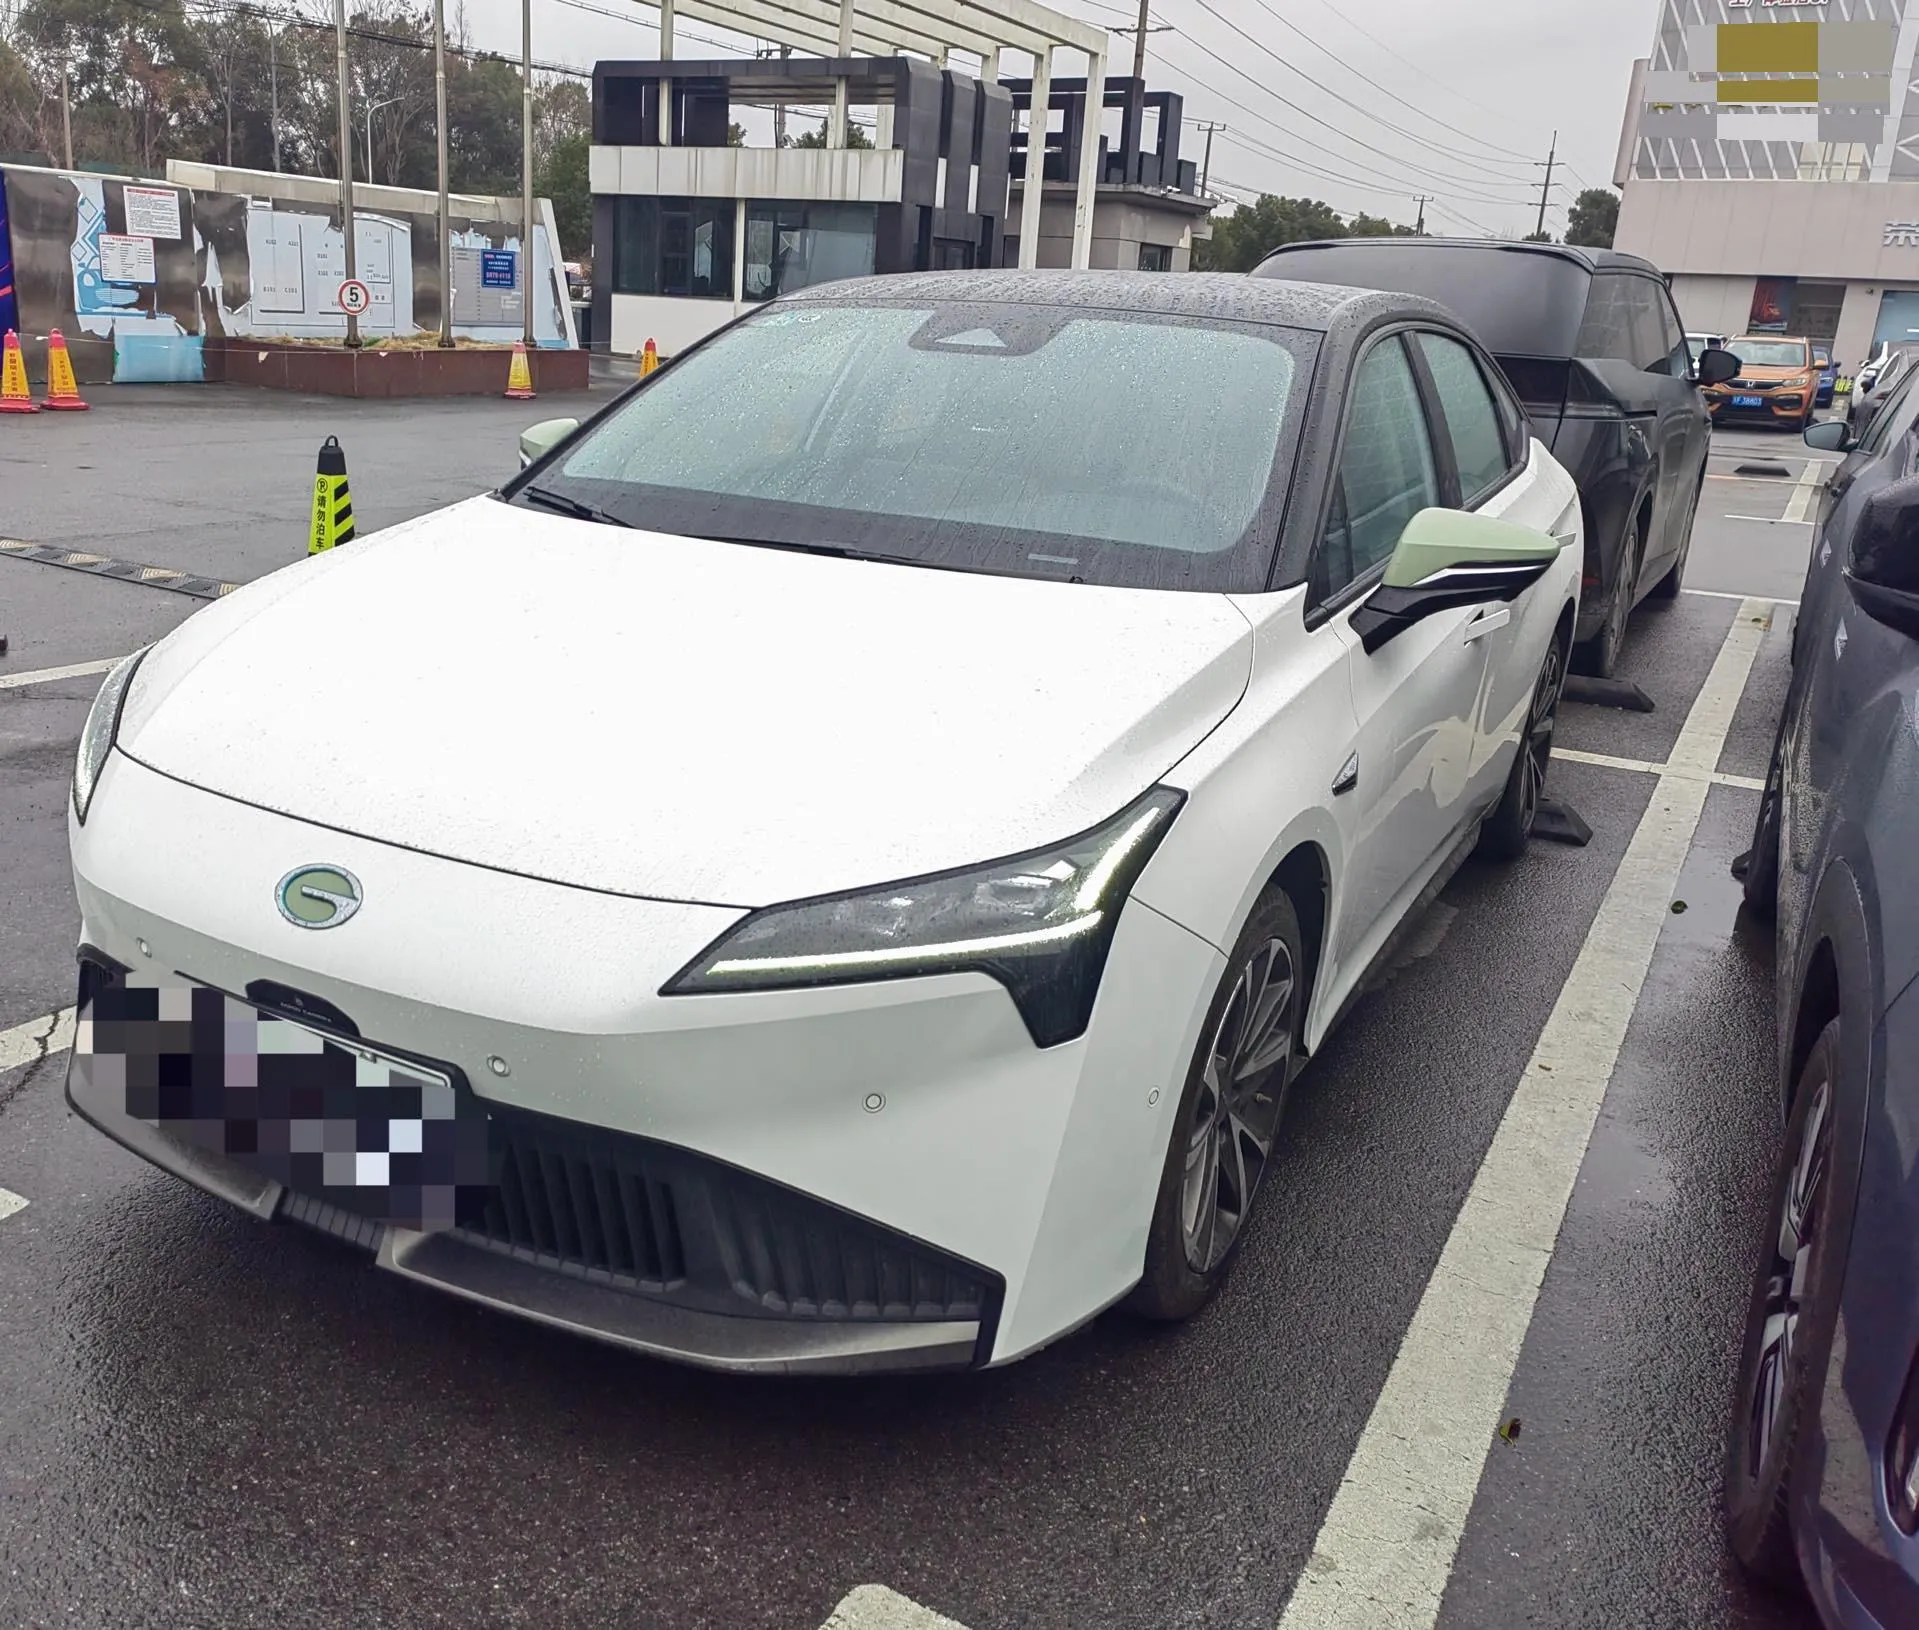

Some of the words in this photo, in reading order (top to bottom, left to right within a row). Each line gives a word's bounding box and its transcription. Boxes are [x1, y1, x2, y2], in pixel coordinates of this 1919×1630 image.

[349, 286, 359, 303] 5
[316, 495, 326, 549] 请勿泊车
